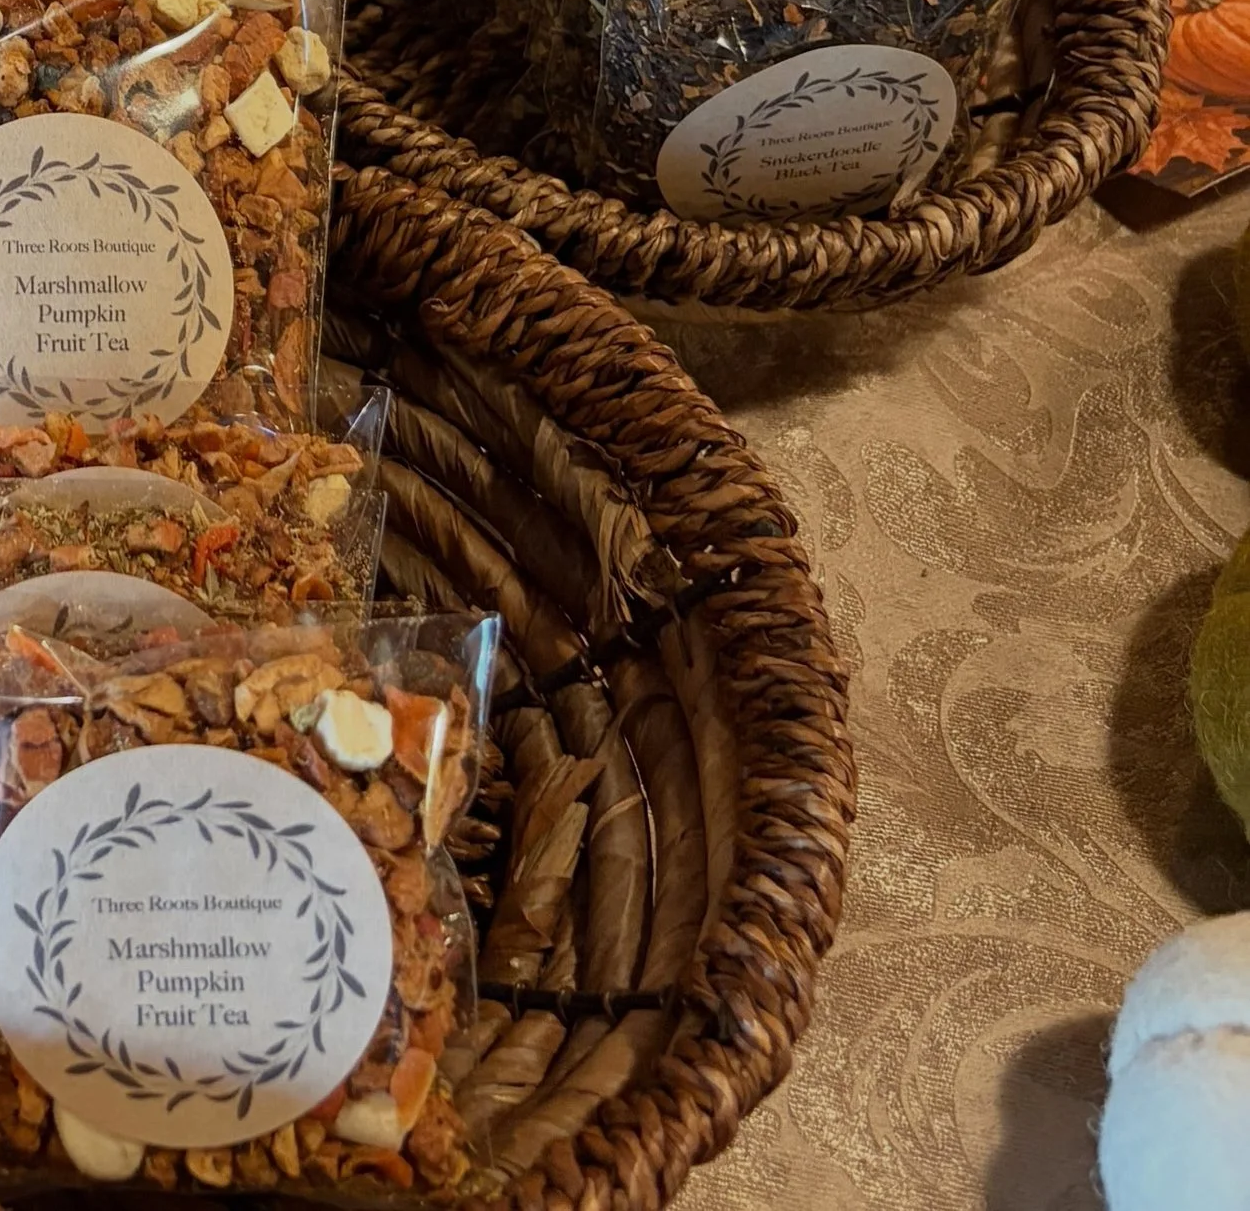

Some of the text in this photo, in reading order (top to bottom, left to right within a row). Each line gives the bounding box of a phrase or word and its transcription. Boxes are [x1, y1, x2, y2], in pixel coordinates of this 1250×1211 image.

[760, 134, 795, 147] Three
[837, 119, 894, 136] Boutique
[759, 140, 882, 169] Snickerdoodle
[773, 160, 862, 181] Black Tea
[2, 239, 157, 257] Three Roots Boutique
[14, 275, 148, 295] Marshmallow
[38, 304, 127, 328] Pumpkin
[36, 332, 130, 353] Fruit Tea
[91, 894, 283, 914] Three Roots Boutique
[107, 936, 272, 960] Marshmallow
[137, 970, 246, 998] Pumpkin
[136, 1003, 251, 1027] Fruit Tea
